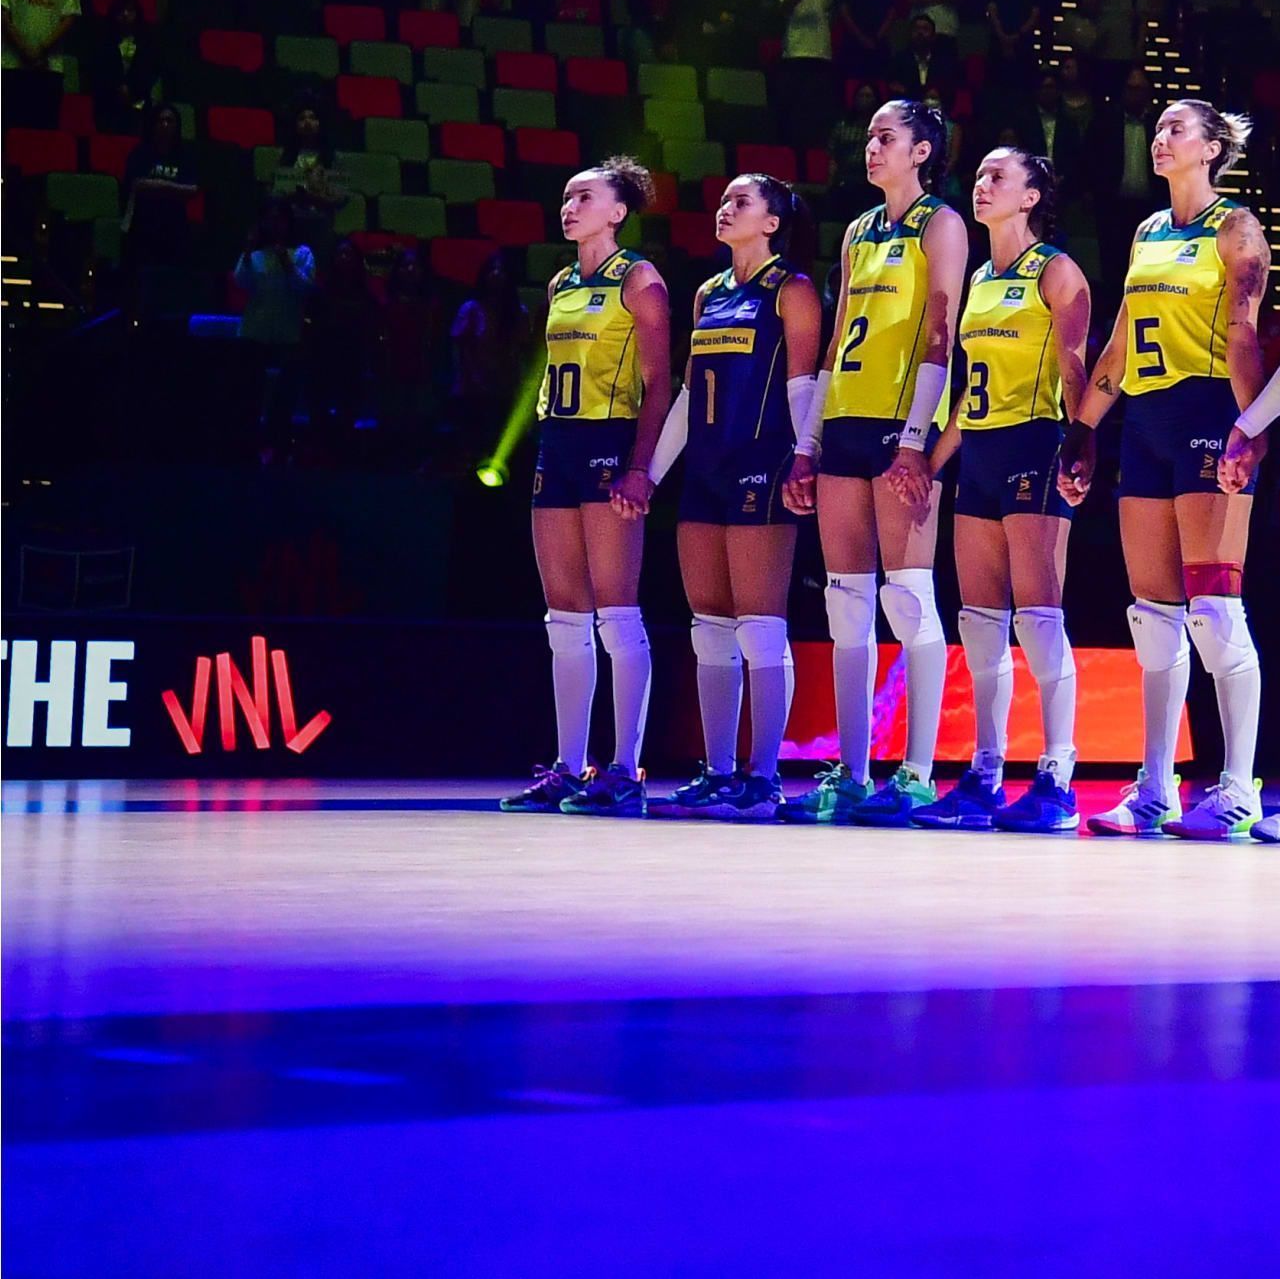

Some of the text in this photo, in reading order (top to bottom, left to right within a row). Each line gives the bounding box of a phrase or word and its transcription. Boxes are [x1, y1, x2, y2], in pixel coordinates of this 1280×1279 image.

[874, 284, 897, 294] BRASIL
[1147, 284, 1157, 292] DO
[1158, 282, 1188, 295] BRASIL
[572, 331, 598, 341] BRASIL
[987, 327, 1019, 338] BRASIL
[721, 334, 749, 345] BRASIL
[840, 316, 868, 372] 2
[1134, 317, 1167, 378] 5
[704, 368, 716, 424] 1
[967, 362, 989, 420] 3
[1190, 438, 1223, 450] enel
[589, 456, 618, 468] enel
[1, 636, 332, 753] HE VNL
